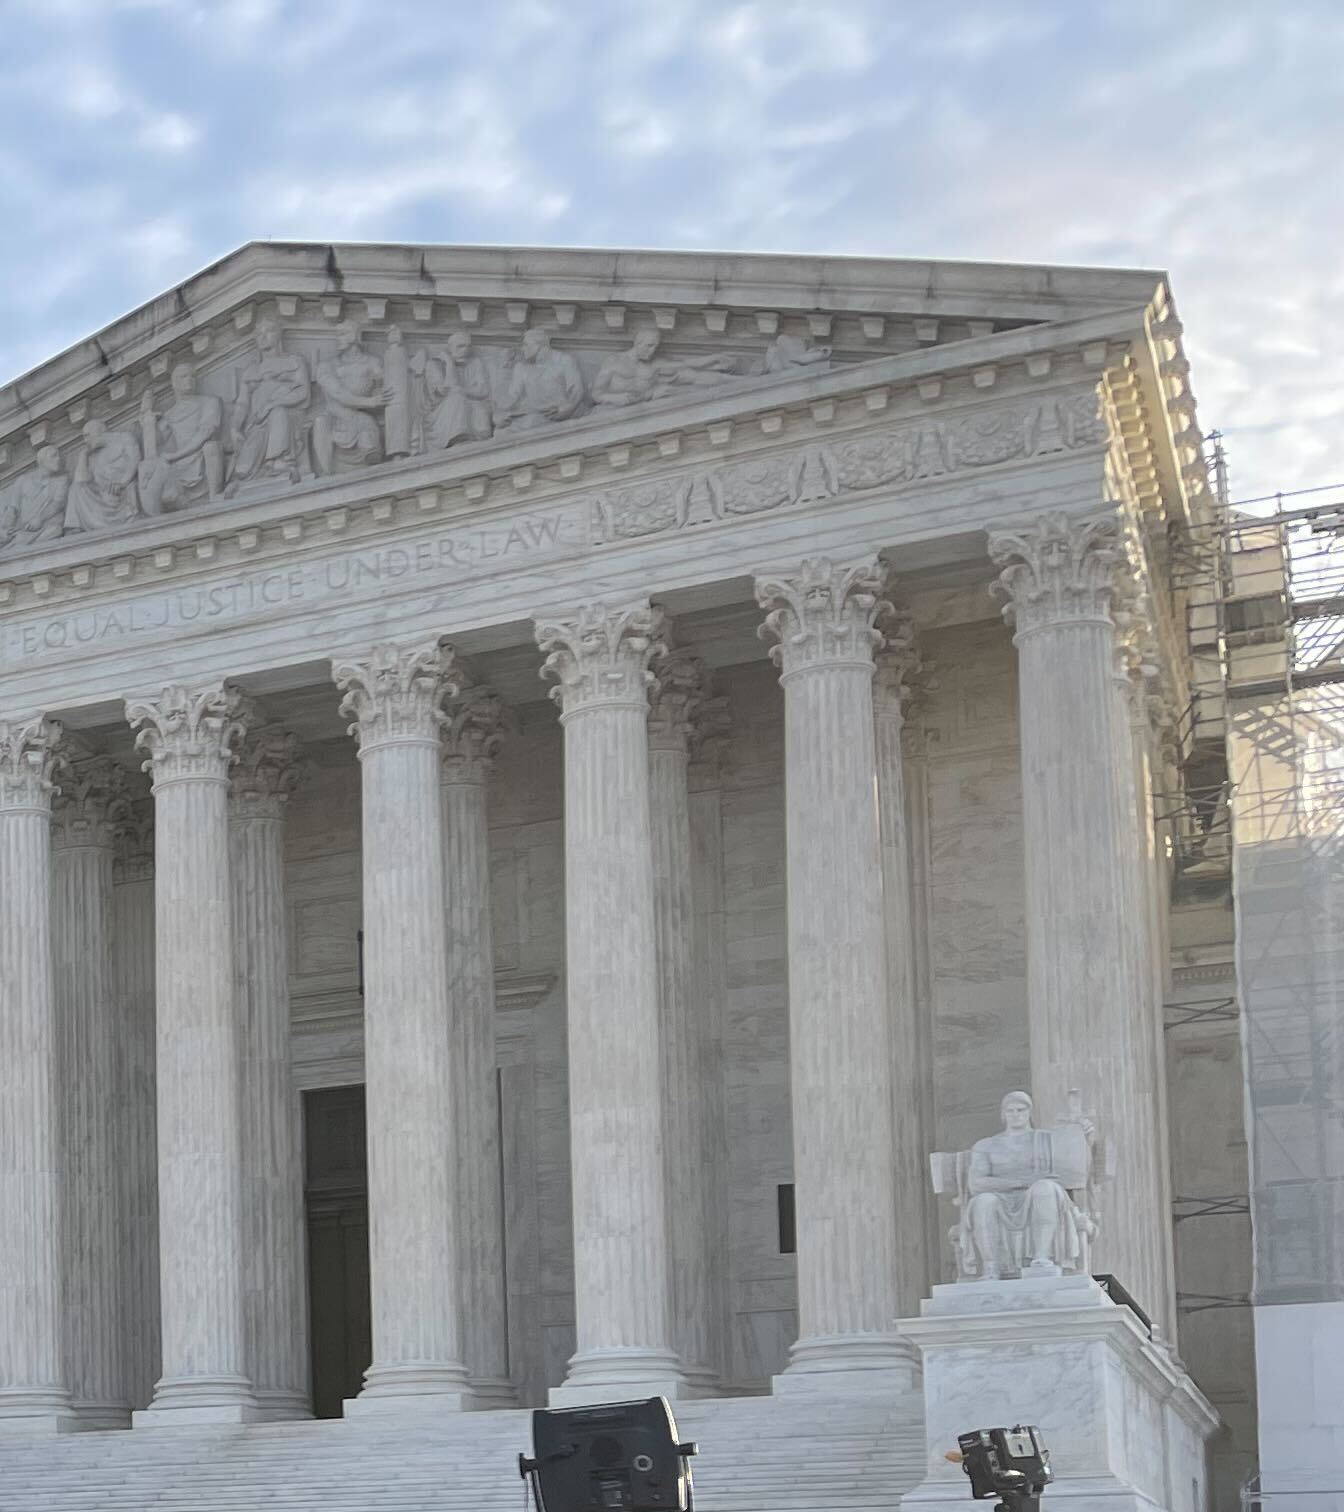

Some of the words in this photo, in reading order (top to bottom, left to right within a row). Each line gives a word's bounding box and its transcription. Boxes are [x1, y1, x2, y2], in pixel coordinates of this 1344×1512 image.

[21, 606, 145, 655] EQUAL
[149, 569, 305, 628] JUSTICE
[326, 538, 466, 590] UNDER
[479, 513, 562, 559] LAW
